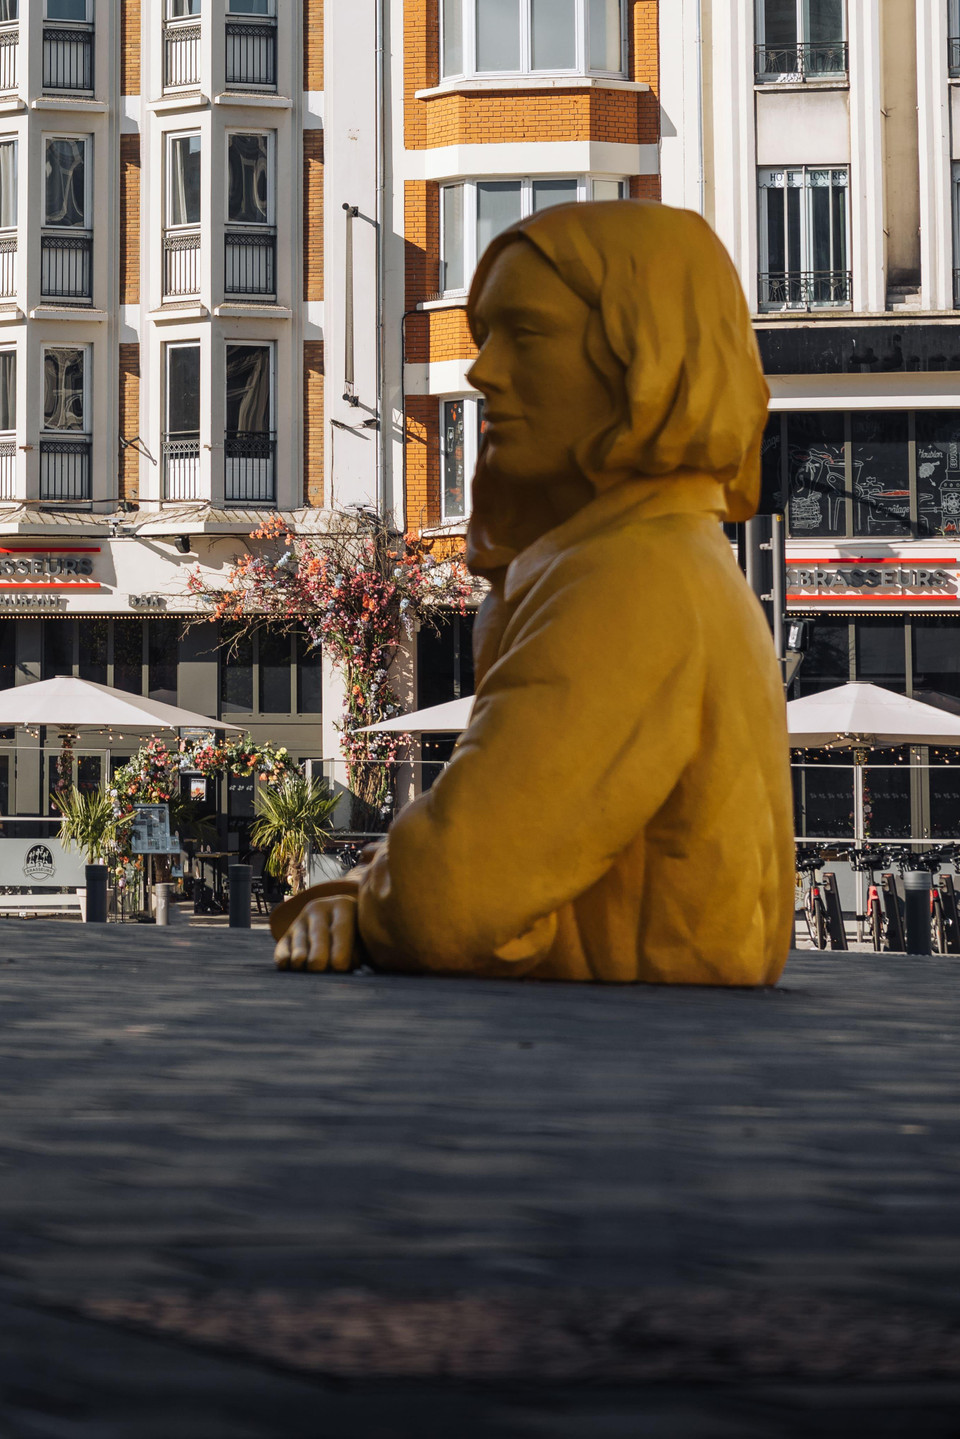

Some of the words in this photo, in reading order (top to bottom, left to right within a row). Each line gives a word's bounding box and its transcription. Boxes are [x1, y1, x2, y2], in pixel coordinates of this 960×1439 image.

[797, 568, 948, 588] BRASSEURS
[128, 594, 159, 607] BAR
[26, 867, 53, 875] BRASSEURS
